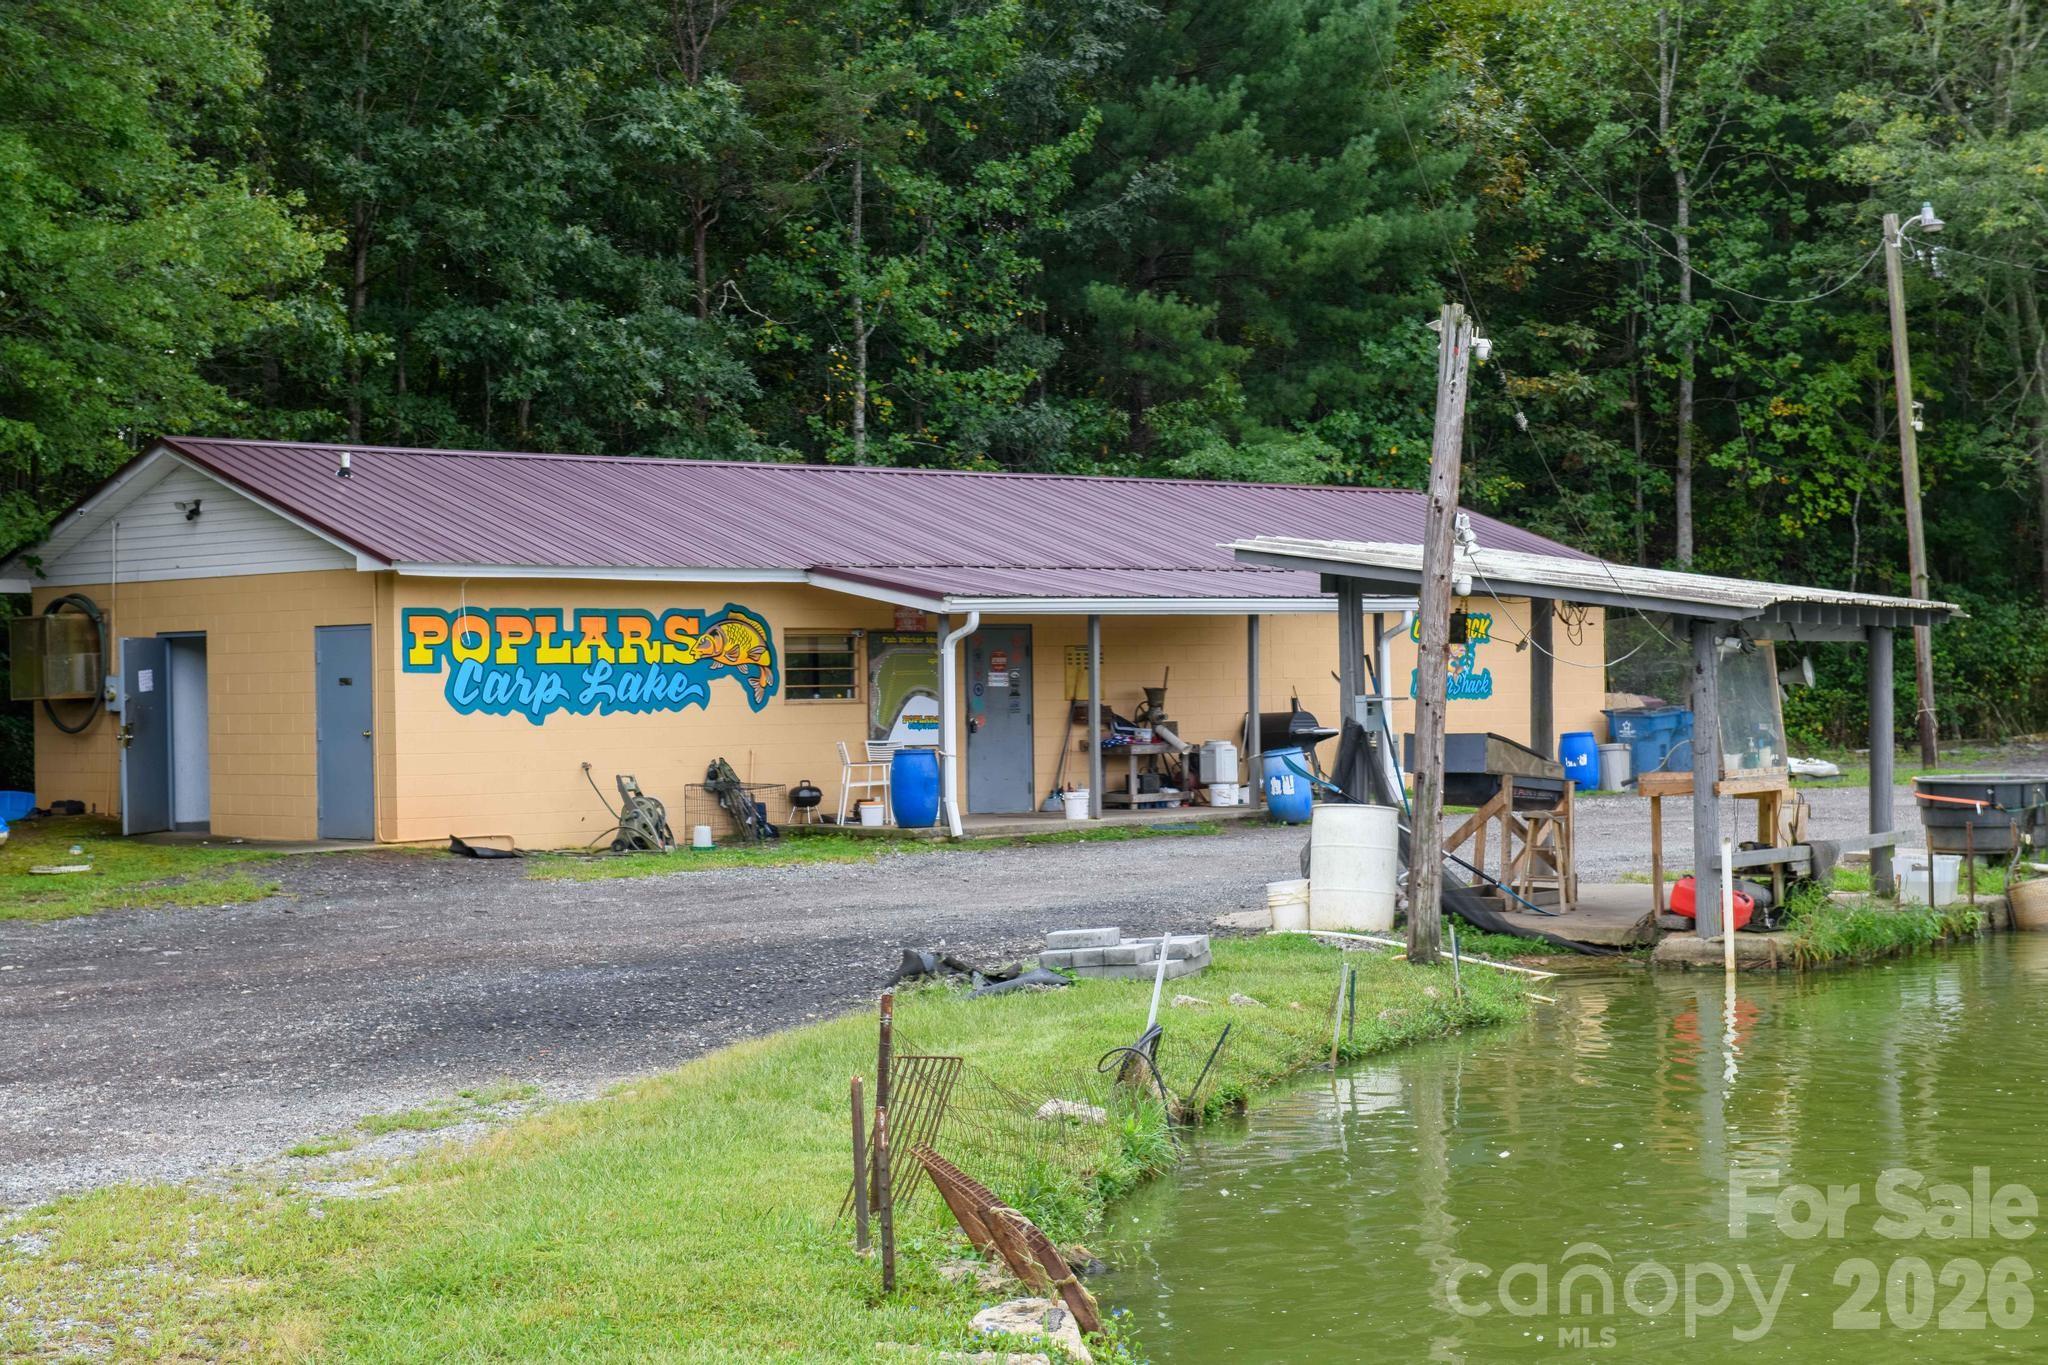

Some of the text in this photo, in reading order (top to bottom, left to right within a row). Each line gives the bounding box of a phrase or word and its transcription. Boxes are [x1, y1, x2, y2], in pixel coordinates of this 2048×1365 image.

[408, 615, 699, 665] POPLARS
[453, 658, 704, 715] Carp Lake
[1453, 672, 1489, 695] Shack
